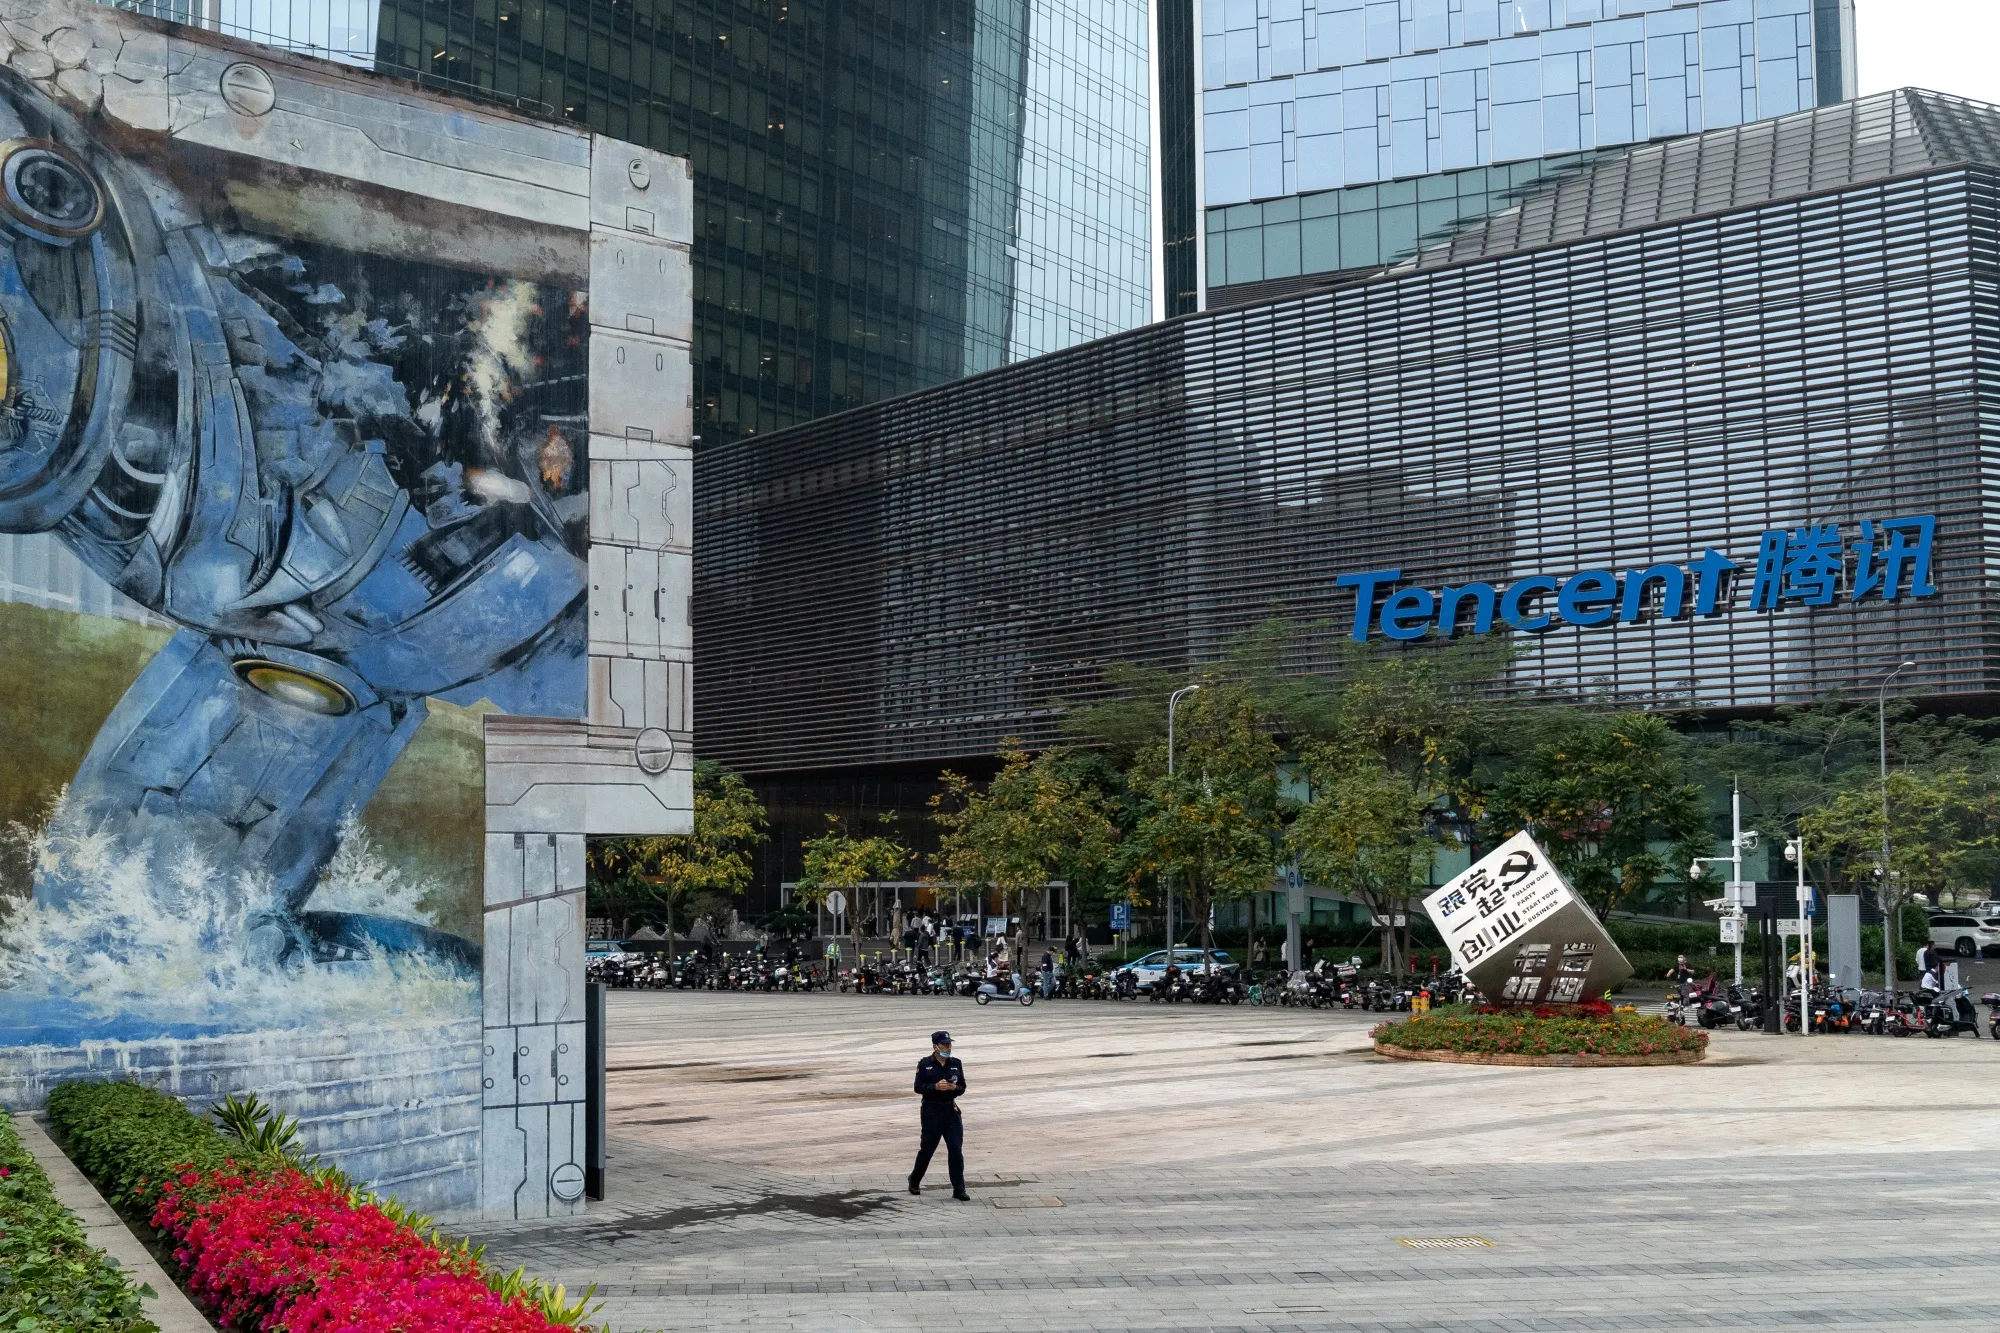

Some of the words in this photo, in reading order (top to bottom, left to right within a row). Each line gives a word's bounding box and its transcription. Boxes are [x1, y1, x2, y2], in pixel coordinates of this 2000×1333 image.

[1336, 547, 1740, 643] Tencent
[1749, 515, 1936, 611] 腾讯
[1512, 880, 1536, 899] FOLLOW
[1536, 870, 1550, 882] OUR
[1114, 906, 1123, 919] P
[1451, 887, 1507, 934] 一起
[1517, 891, 1537, 907] PARTY
[1522, 901, 1542, 915] START
[1542, 887, 1559, 901] YOUR
[1527, 899, 1559, 923] BUSINESS
[1459, 910, 1527, 964] 创业
